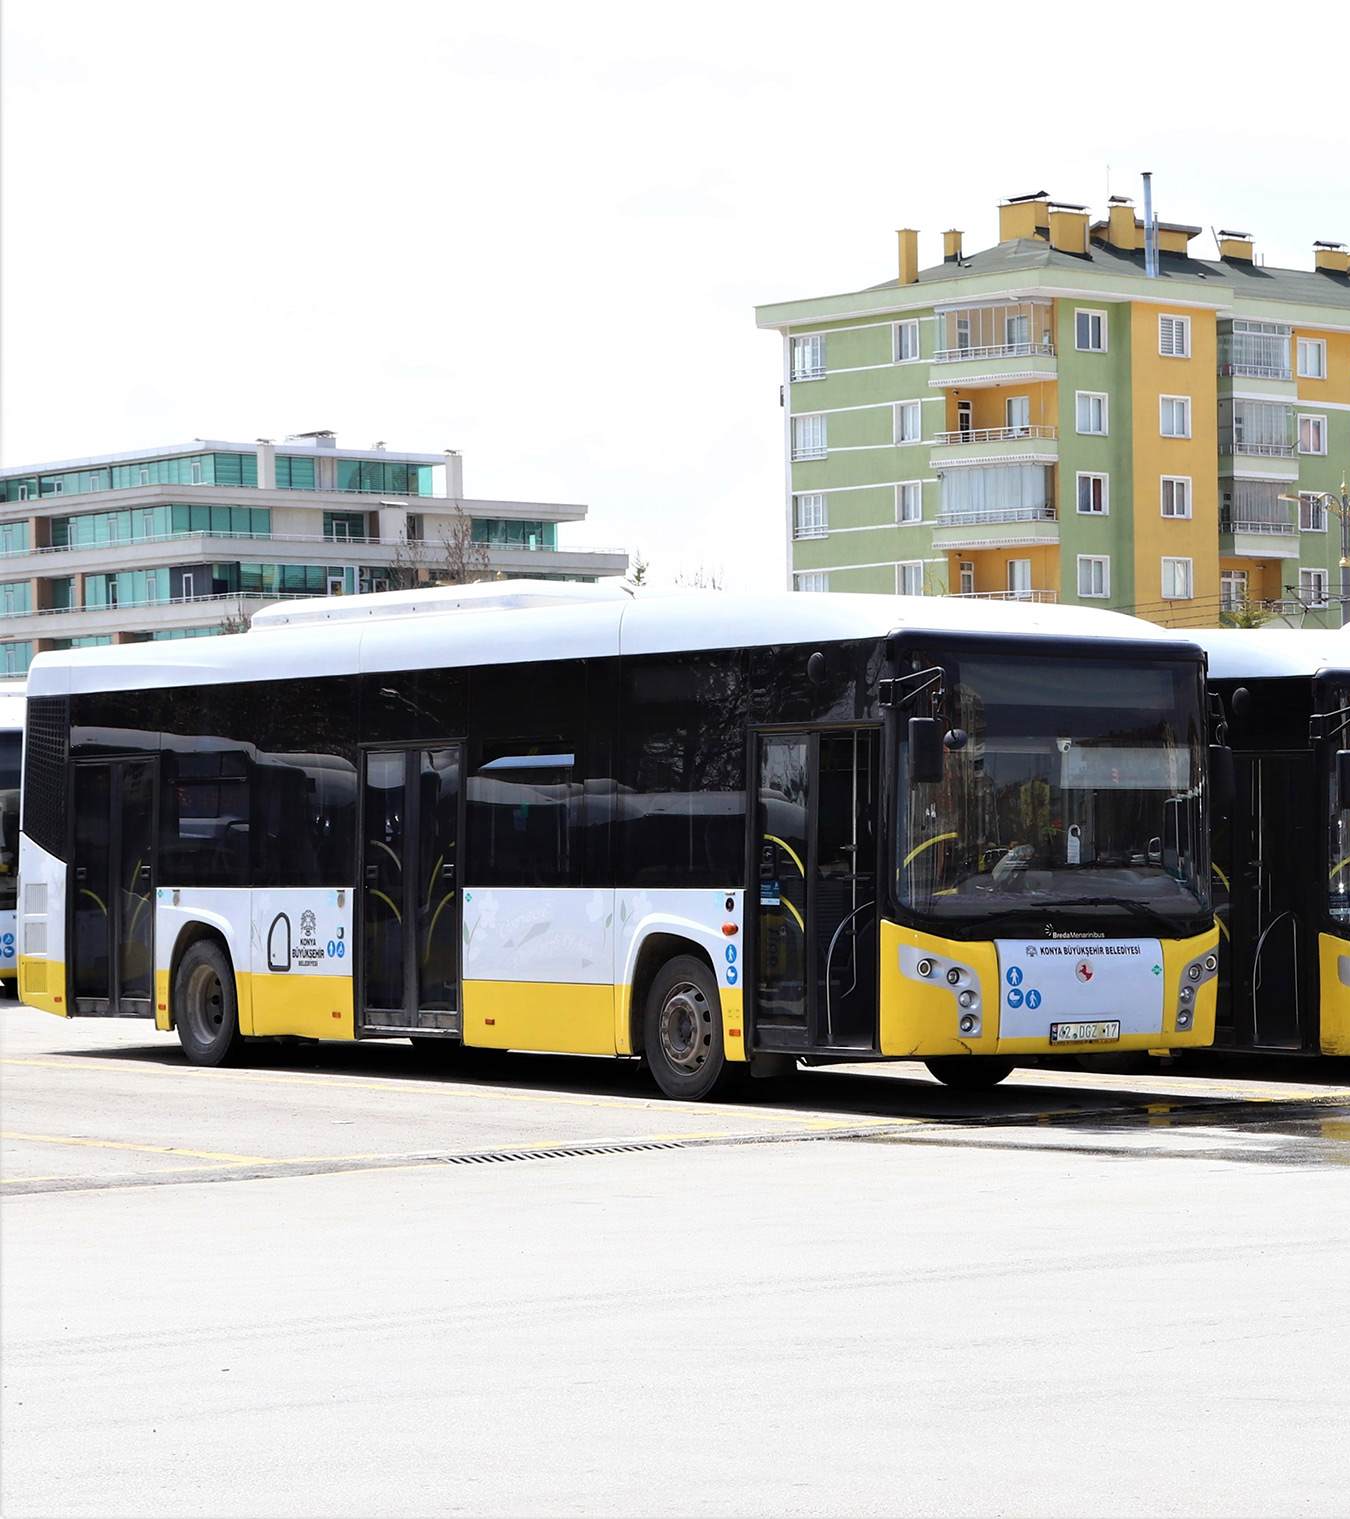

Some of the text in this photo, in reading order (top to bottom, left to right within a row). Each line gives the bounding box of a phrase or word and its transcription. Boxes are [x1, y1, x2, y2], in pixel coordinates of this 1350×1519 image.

[1040, 944, 1141, 957] KONYA BÜYÜKŞEHİR BELEDİYESİ
[1058, 1023, 1118, 1039] 42 DGZ 17
